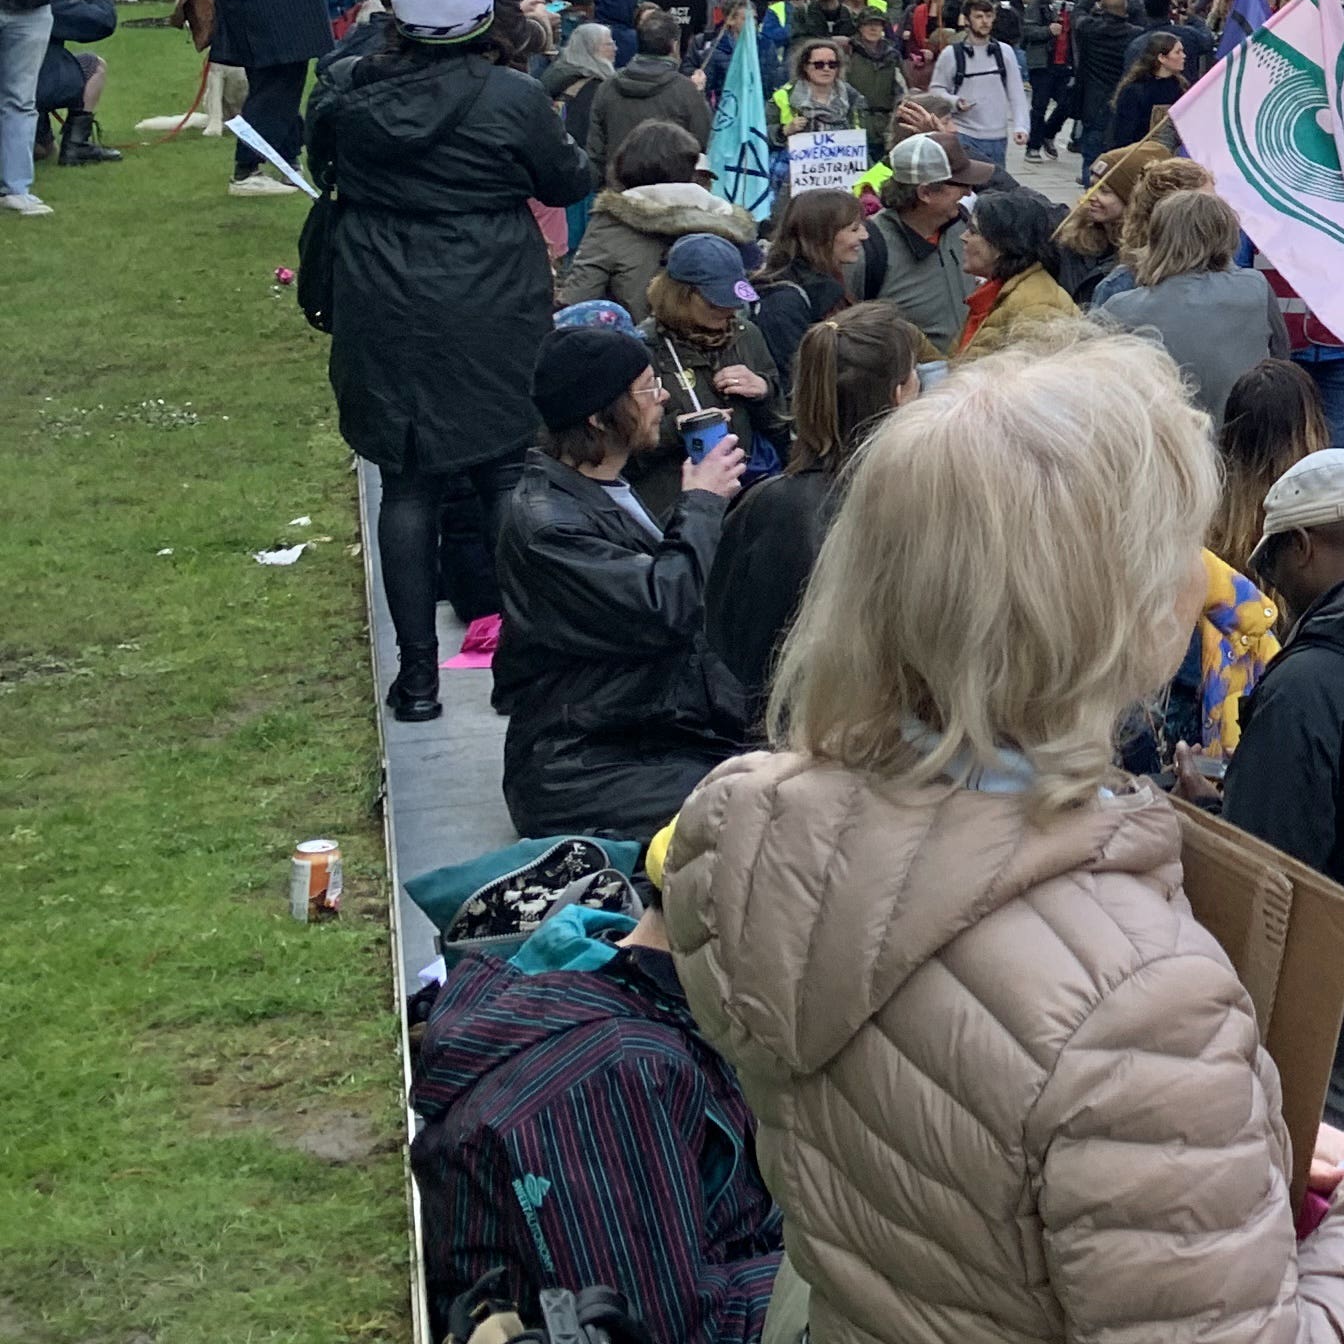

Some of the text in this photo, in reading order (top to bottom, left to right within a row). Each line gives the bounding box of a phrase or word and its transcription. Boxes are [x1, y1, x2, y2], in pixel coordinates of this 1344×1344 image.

[671, 7, 690, 17] ACT
[673, 16, 691, 25] OW
[813, 133, 834, 146] UK
[789, 145, 865, 161] GOVERNMENT
[794, 175, 842, 187] ASYLUM
